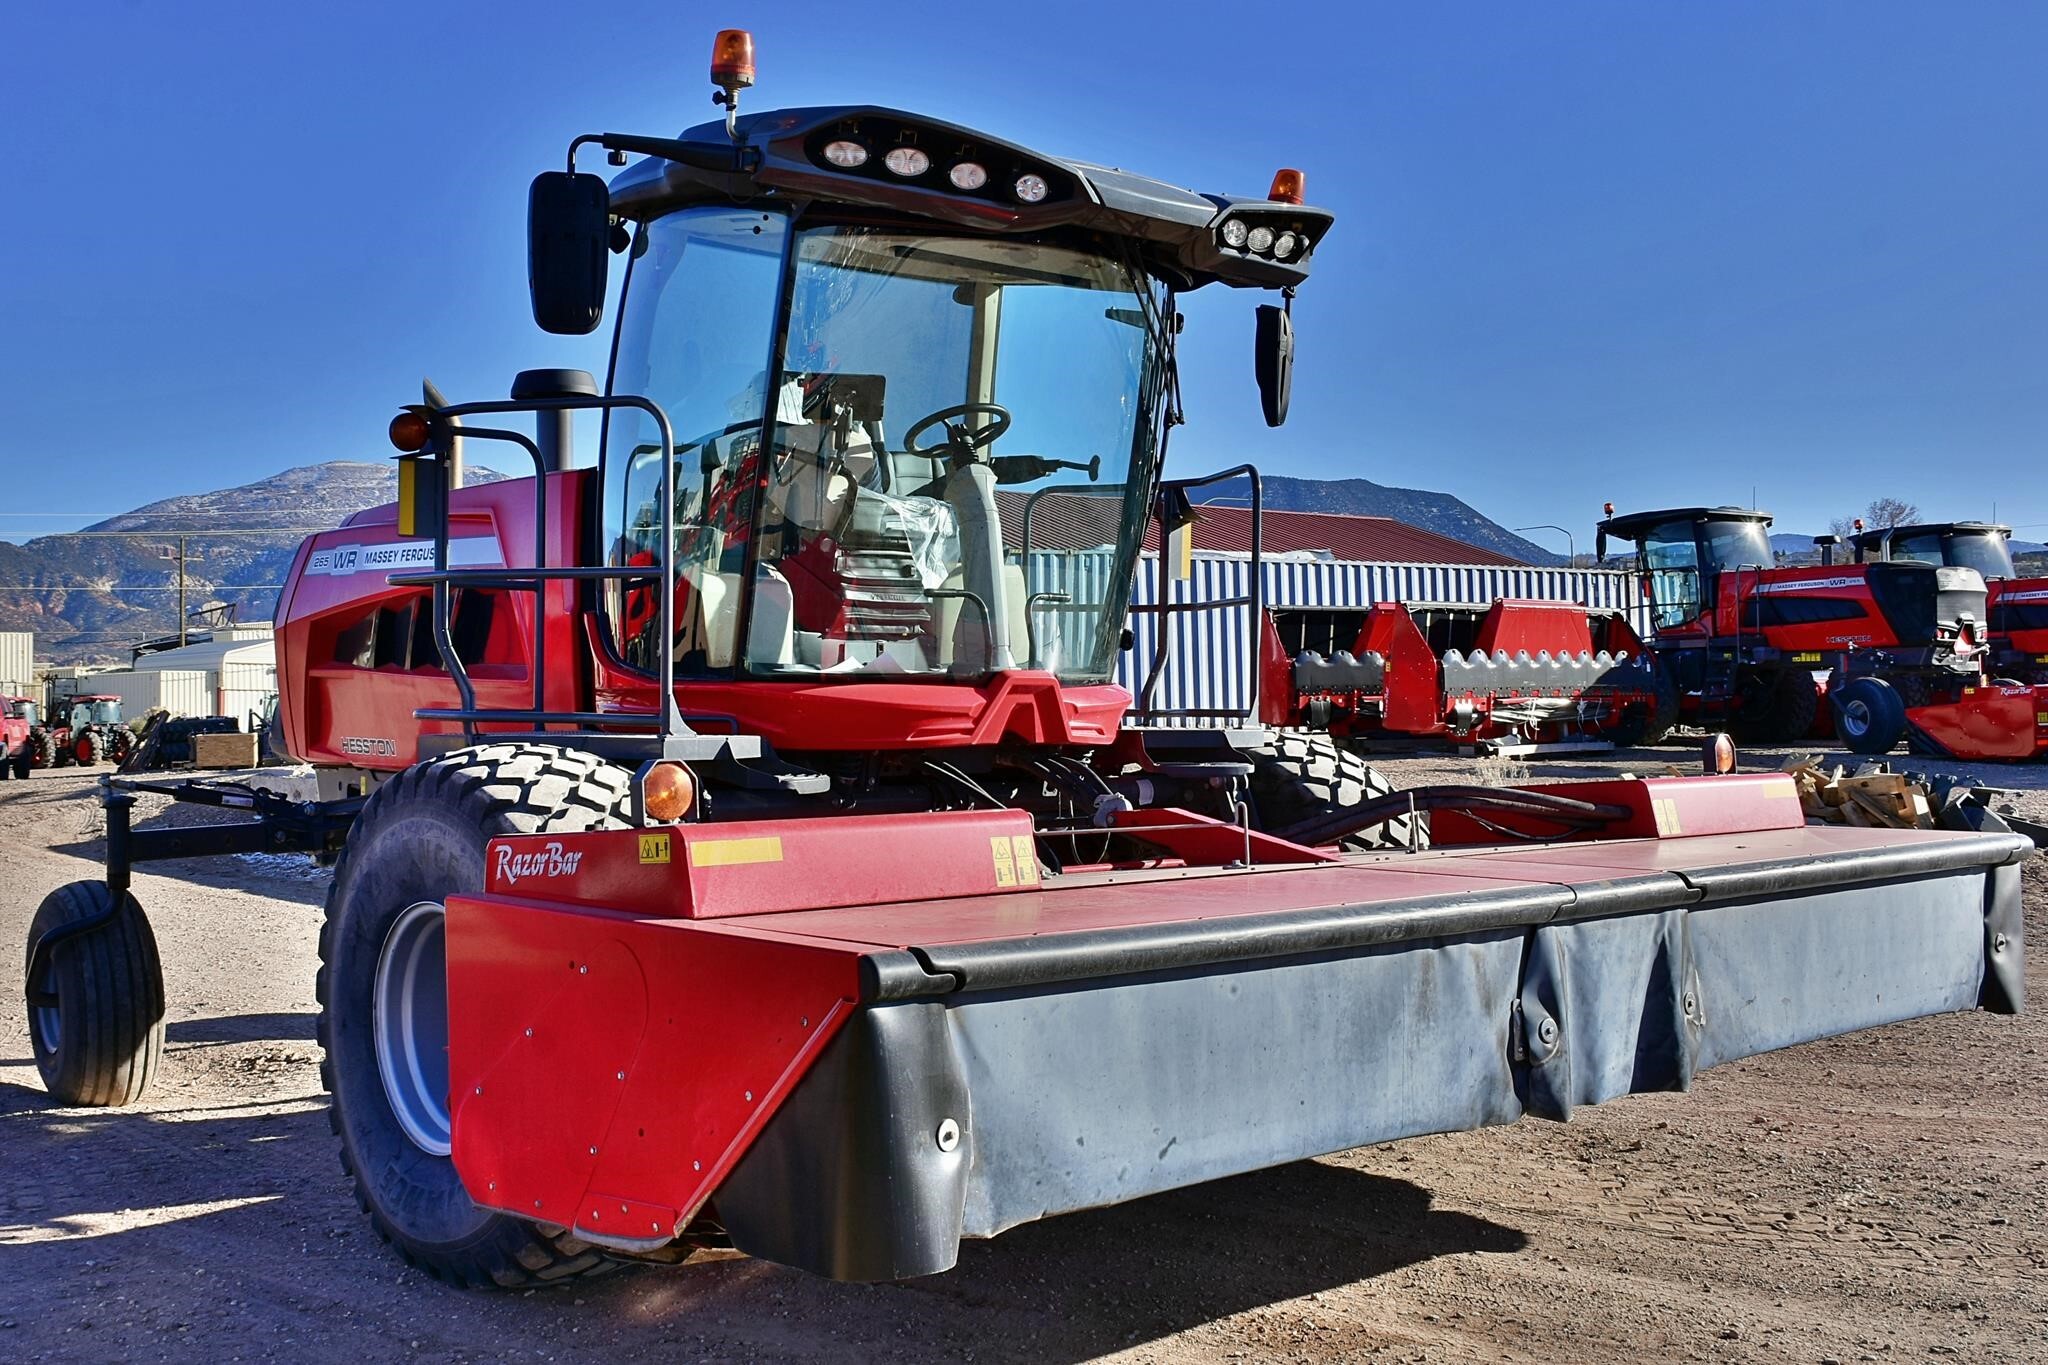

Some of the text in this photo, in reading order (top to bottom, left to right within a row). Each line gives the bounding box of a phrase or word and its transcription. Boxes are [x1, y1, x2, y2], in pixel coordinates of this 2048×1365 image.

[313, 556, 330, 568] 265
[332, 551, 358, 569] WR
[364, 551, 400, 564] MASSEY
[341, 737, 397, 757] HESSTON
